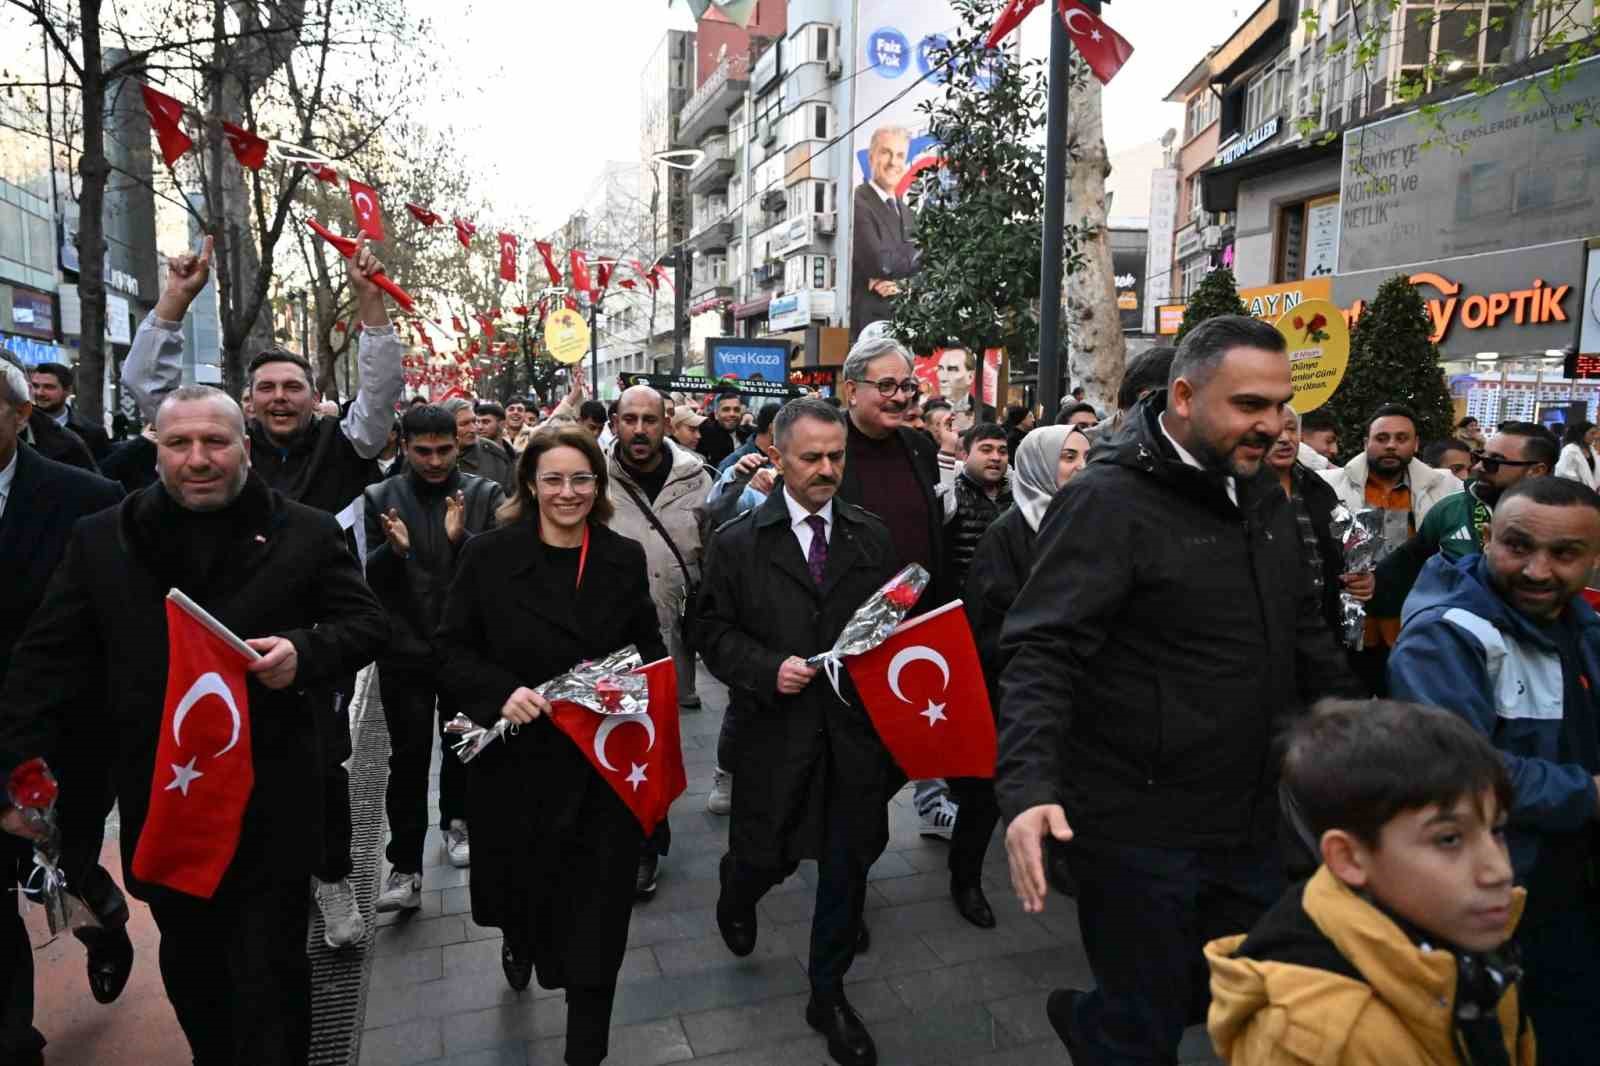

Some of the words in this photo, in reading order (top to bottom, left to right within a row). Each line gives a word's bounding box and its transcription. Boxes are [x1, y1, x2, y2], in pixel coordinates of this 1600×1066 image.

[1246, 118, 1278, 150] GALLERY
[1460, 278, 1569, 329] OPTİK
[718, 351, 746, 365] Yeni
